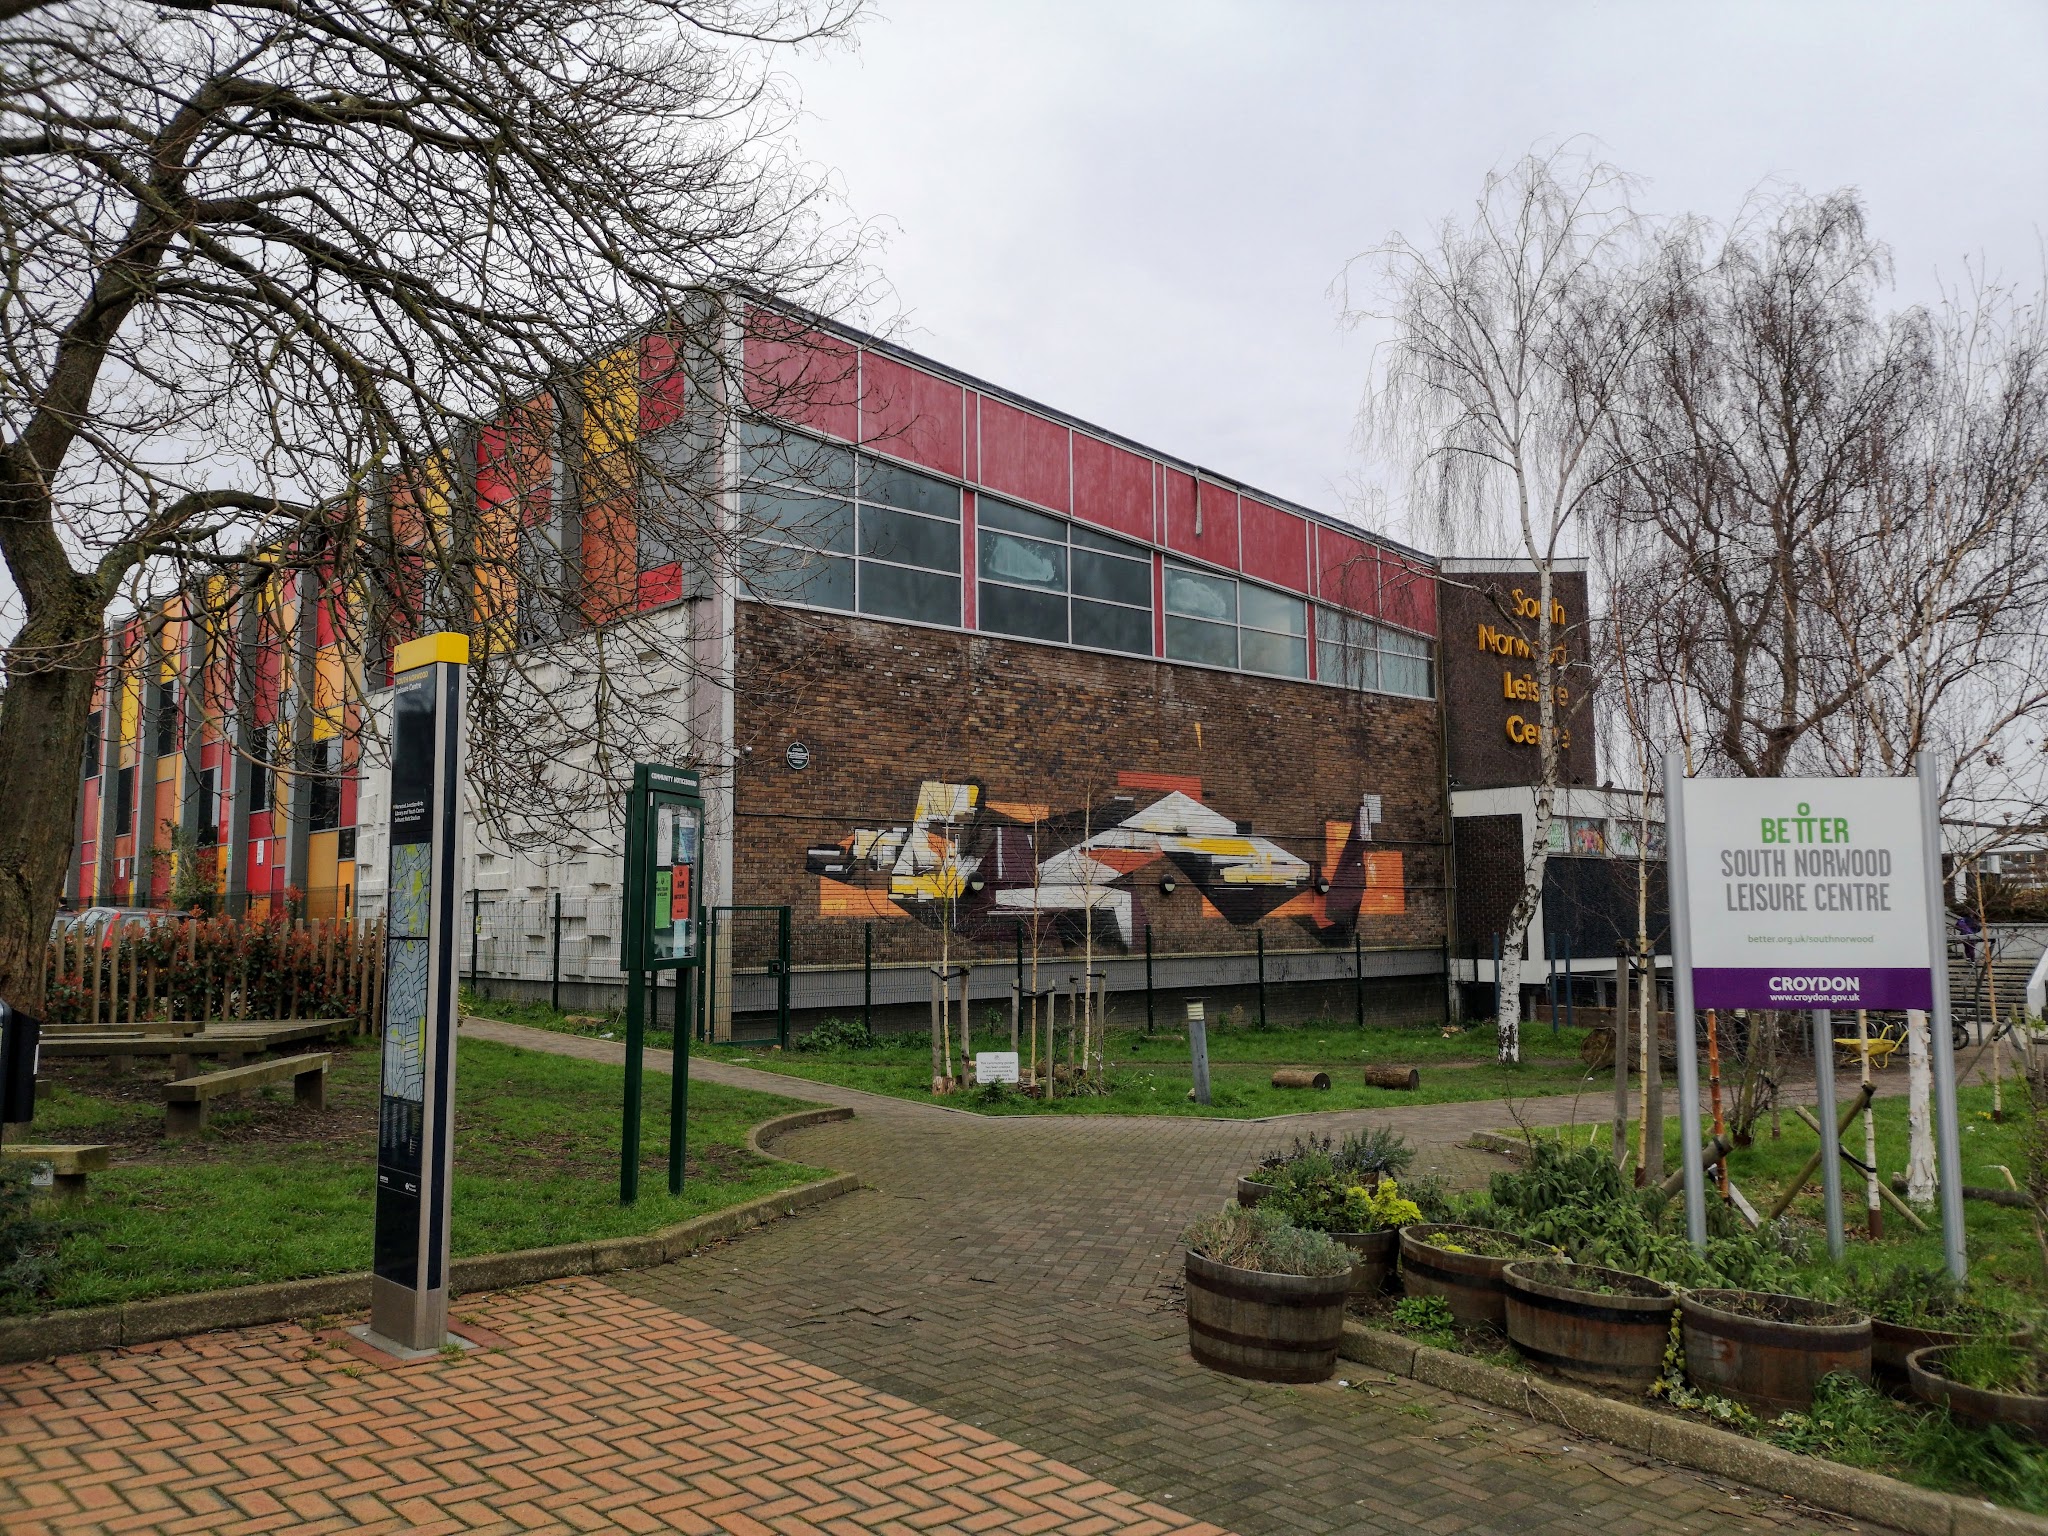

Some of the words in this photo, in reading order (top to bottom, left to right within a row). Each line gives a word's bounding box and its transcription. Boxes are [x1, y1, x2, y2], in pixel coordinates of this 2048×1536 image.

[1512, 589, 1566, 625] Soh
[1478, 623, 1567, 665] Norwd
[408, 671, 428, 681] NORWOOD
[1504, 671, 1569, 706] Leise
[396, 686, 408, 694] Leisure
[1506, 714, 1571, 748] Cee
[651, 772, 673, 782] COMMUNITY
[674, 777, 697, 786] NOTICEBOARD
[1761, 817, 1850, 844] BETTER
[1721, 848, 1786, 877] SOUTH
[1795, 848, 1892, 877] NORWOOD
[1726, 882, 1808, 912] LEISURE
[1814, 882, 1891, 912] CENTRE
[1747, 934, 1874, 945] better.org.uk/southnorwood
[1769, 976, 1860, 992] CROYDON
[1770, 993, 1860, 1002] www.croydon.gov.uk
